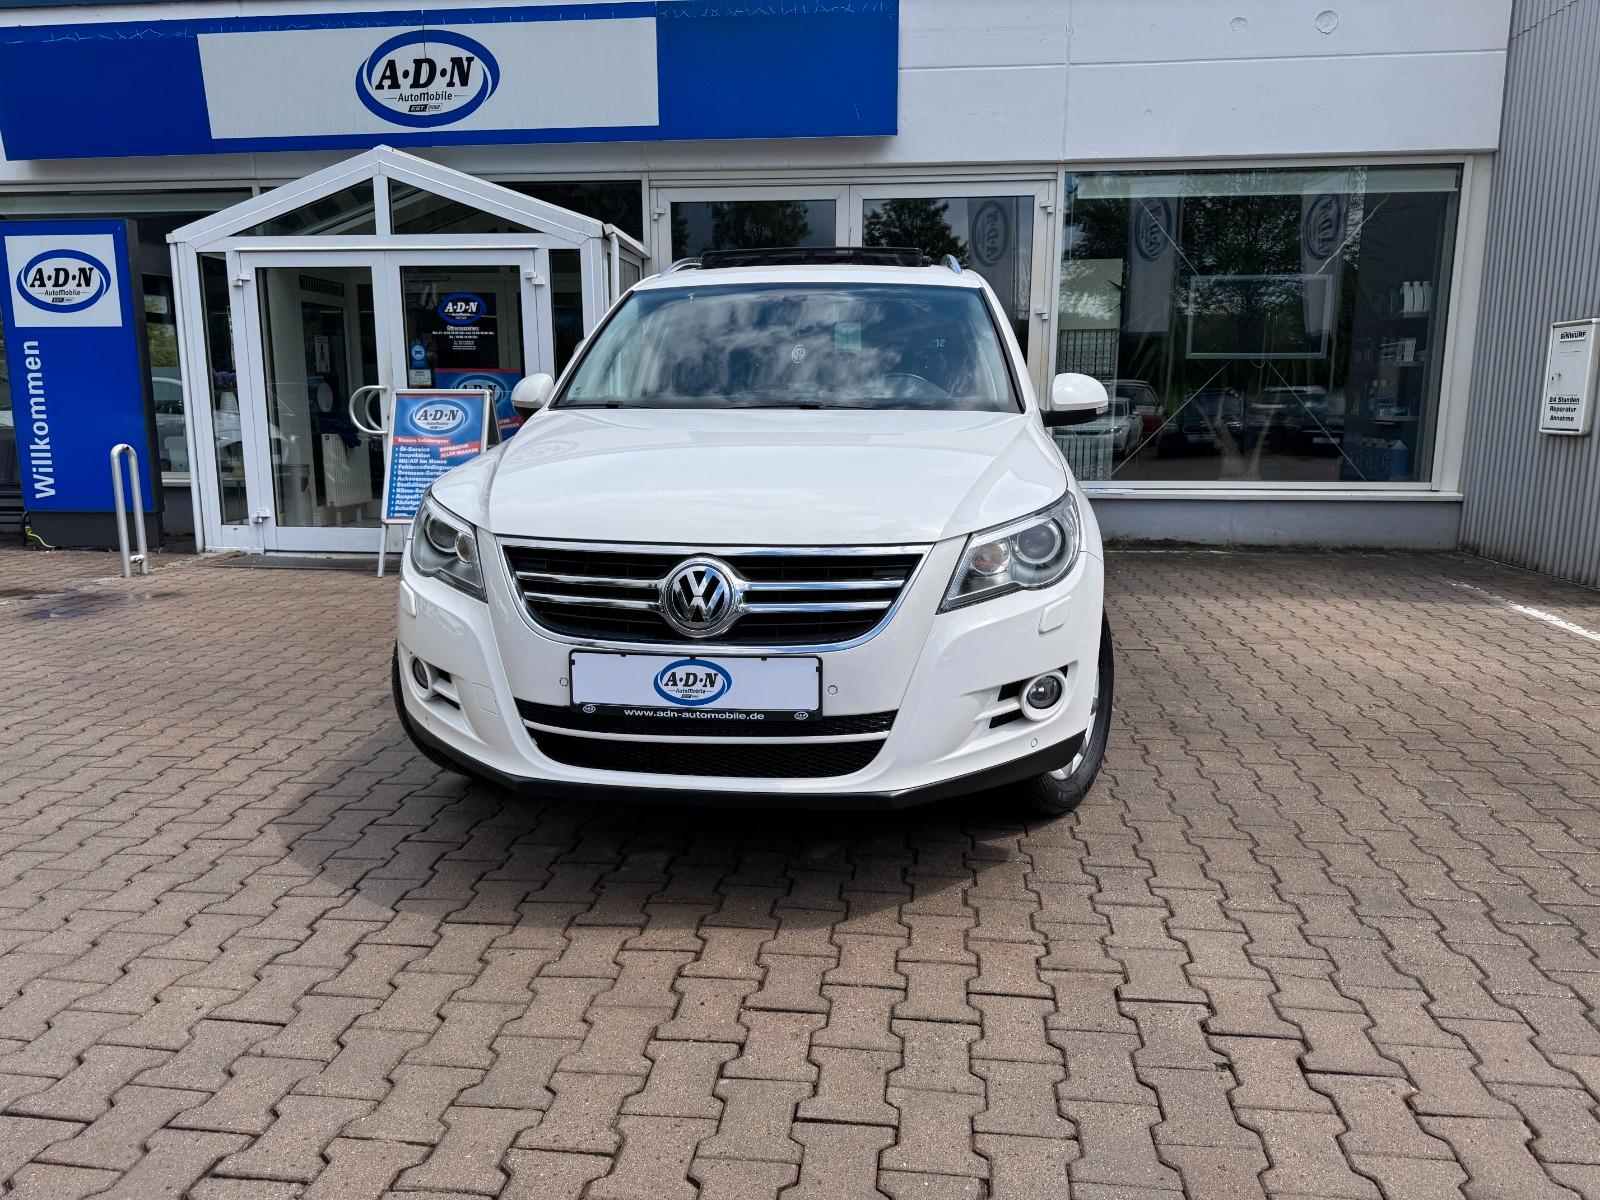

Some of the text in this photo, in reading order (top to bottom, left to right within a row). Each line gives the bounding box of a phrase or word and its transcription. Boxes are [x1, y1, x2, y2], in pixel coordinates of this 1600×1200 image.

[398, 91, 453, 102] AutoMobile
[23, 340, 56, 499] Willkommen
[624, 708, 765, 720] www.adn-automobile.de
